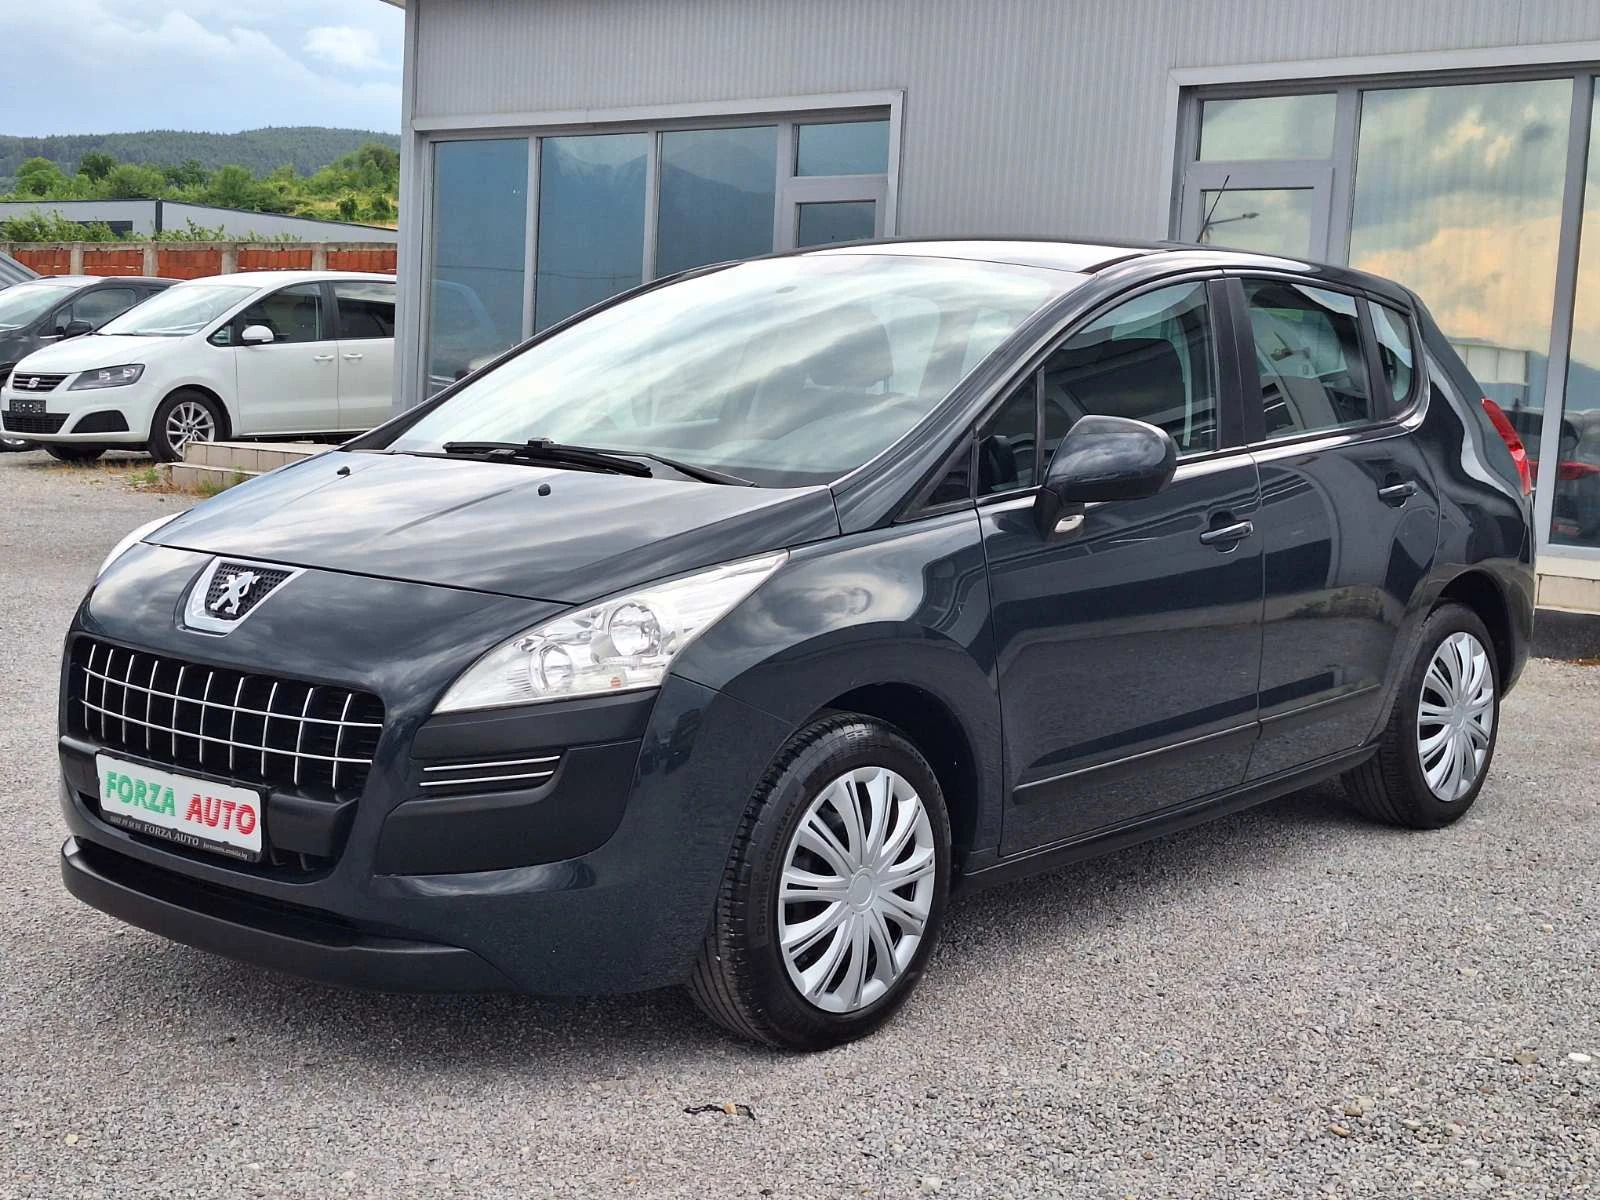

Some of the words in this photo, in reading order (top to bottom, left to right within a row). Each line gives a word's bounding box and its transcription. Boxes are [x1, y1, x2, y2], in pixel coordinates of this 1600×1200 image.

[105, 771, 176, 816] FORZA
[184, 794, 256, 835] AUTO
[144, 824, 172, 840] FORZA
[173, 833, 199, 846] AUTO
